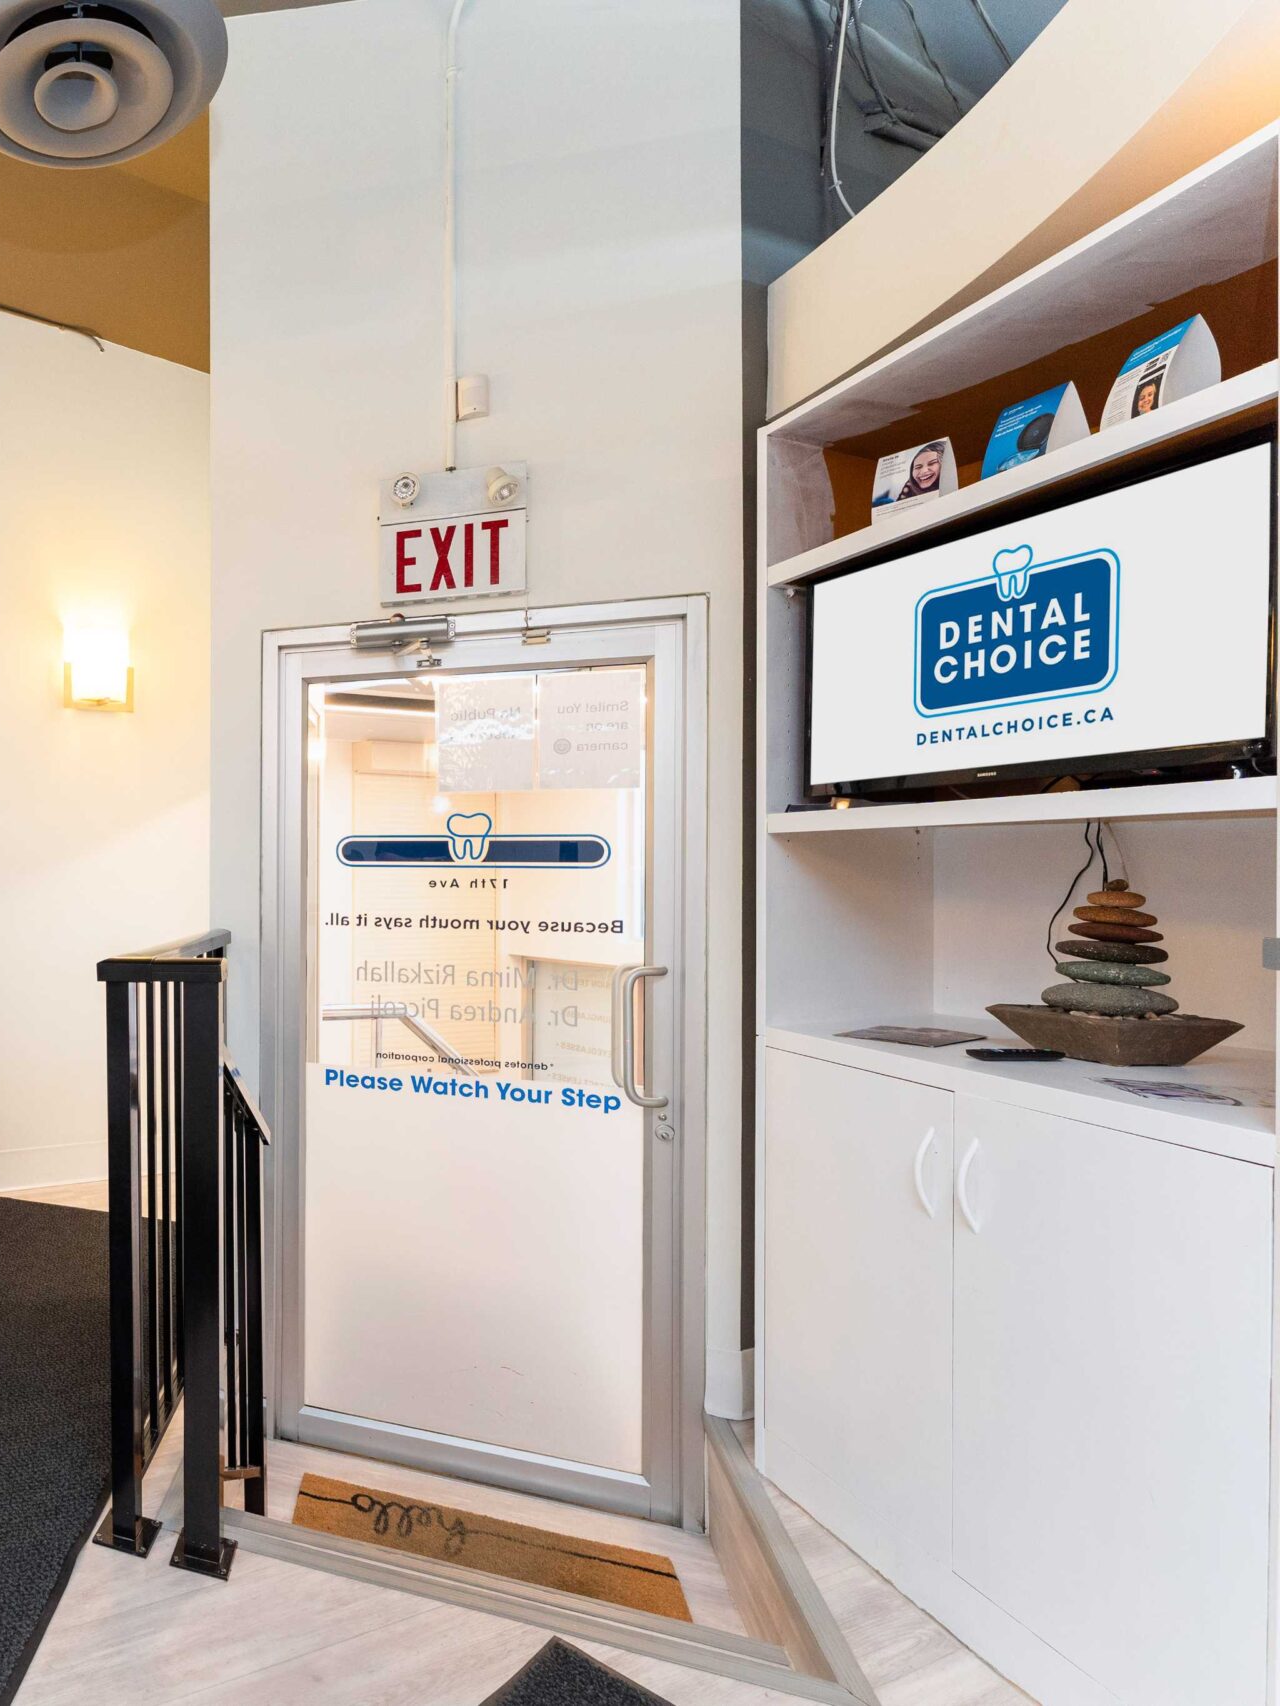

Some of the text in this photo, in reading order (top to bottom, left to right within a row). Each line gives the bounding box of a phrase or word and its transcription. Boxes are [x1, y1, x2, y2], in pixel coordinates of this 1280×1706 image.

[395, 518, 509, 594] EXIT
[938, 591, 1091, 651] DENTAL
[932, 628, 1091, 685] CHOICE
[915, 706, 1115, 747] DENTALCHOICE.CA
[325, 1068, 622, 1114] Please Watch Your Step
